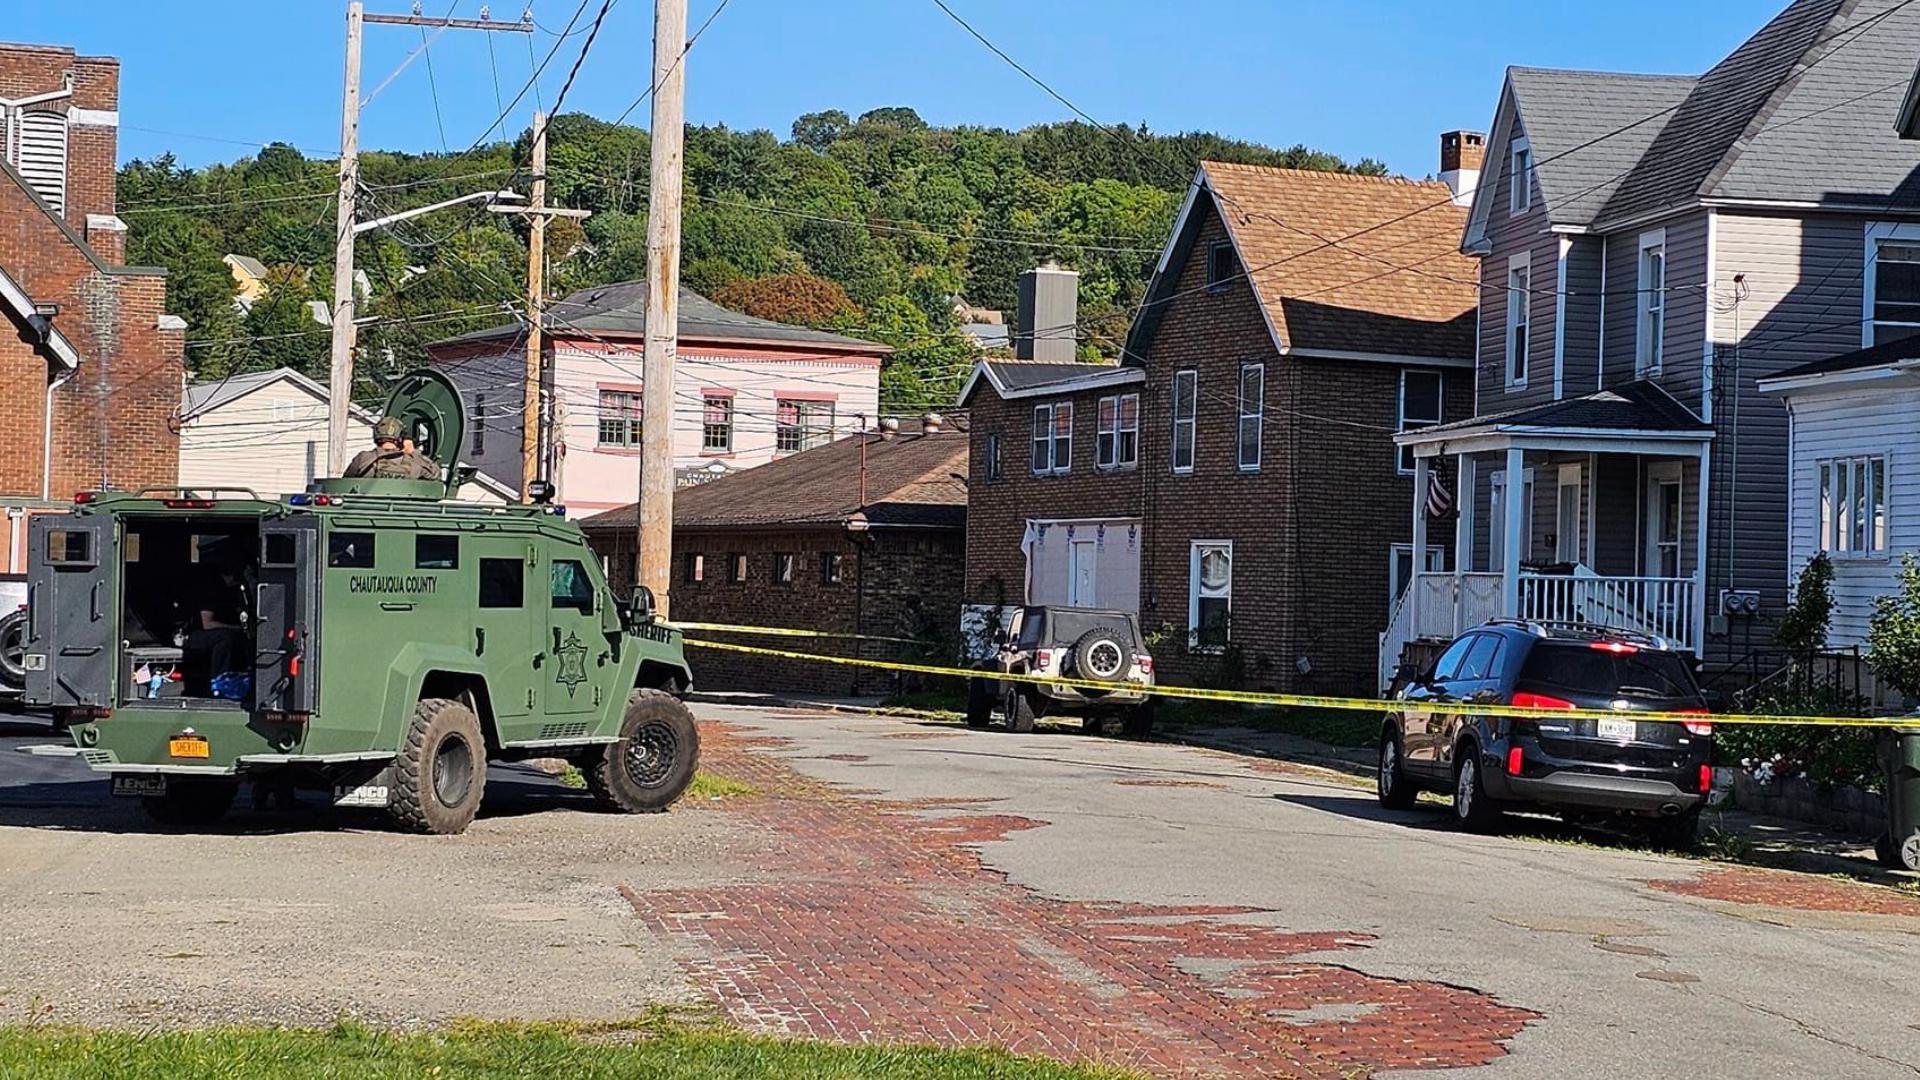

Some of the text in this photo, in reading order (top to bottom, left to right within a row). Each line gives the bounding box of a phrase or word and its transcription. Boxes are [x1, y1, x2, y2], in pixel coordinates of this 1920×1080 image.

[350, 576, 438, 593] CHAUTAUQUA COUNTY
[629, 625, 672, 644] SHERIFF
[334, 785, 388, 798] LENCO
